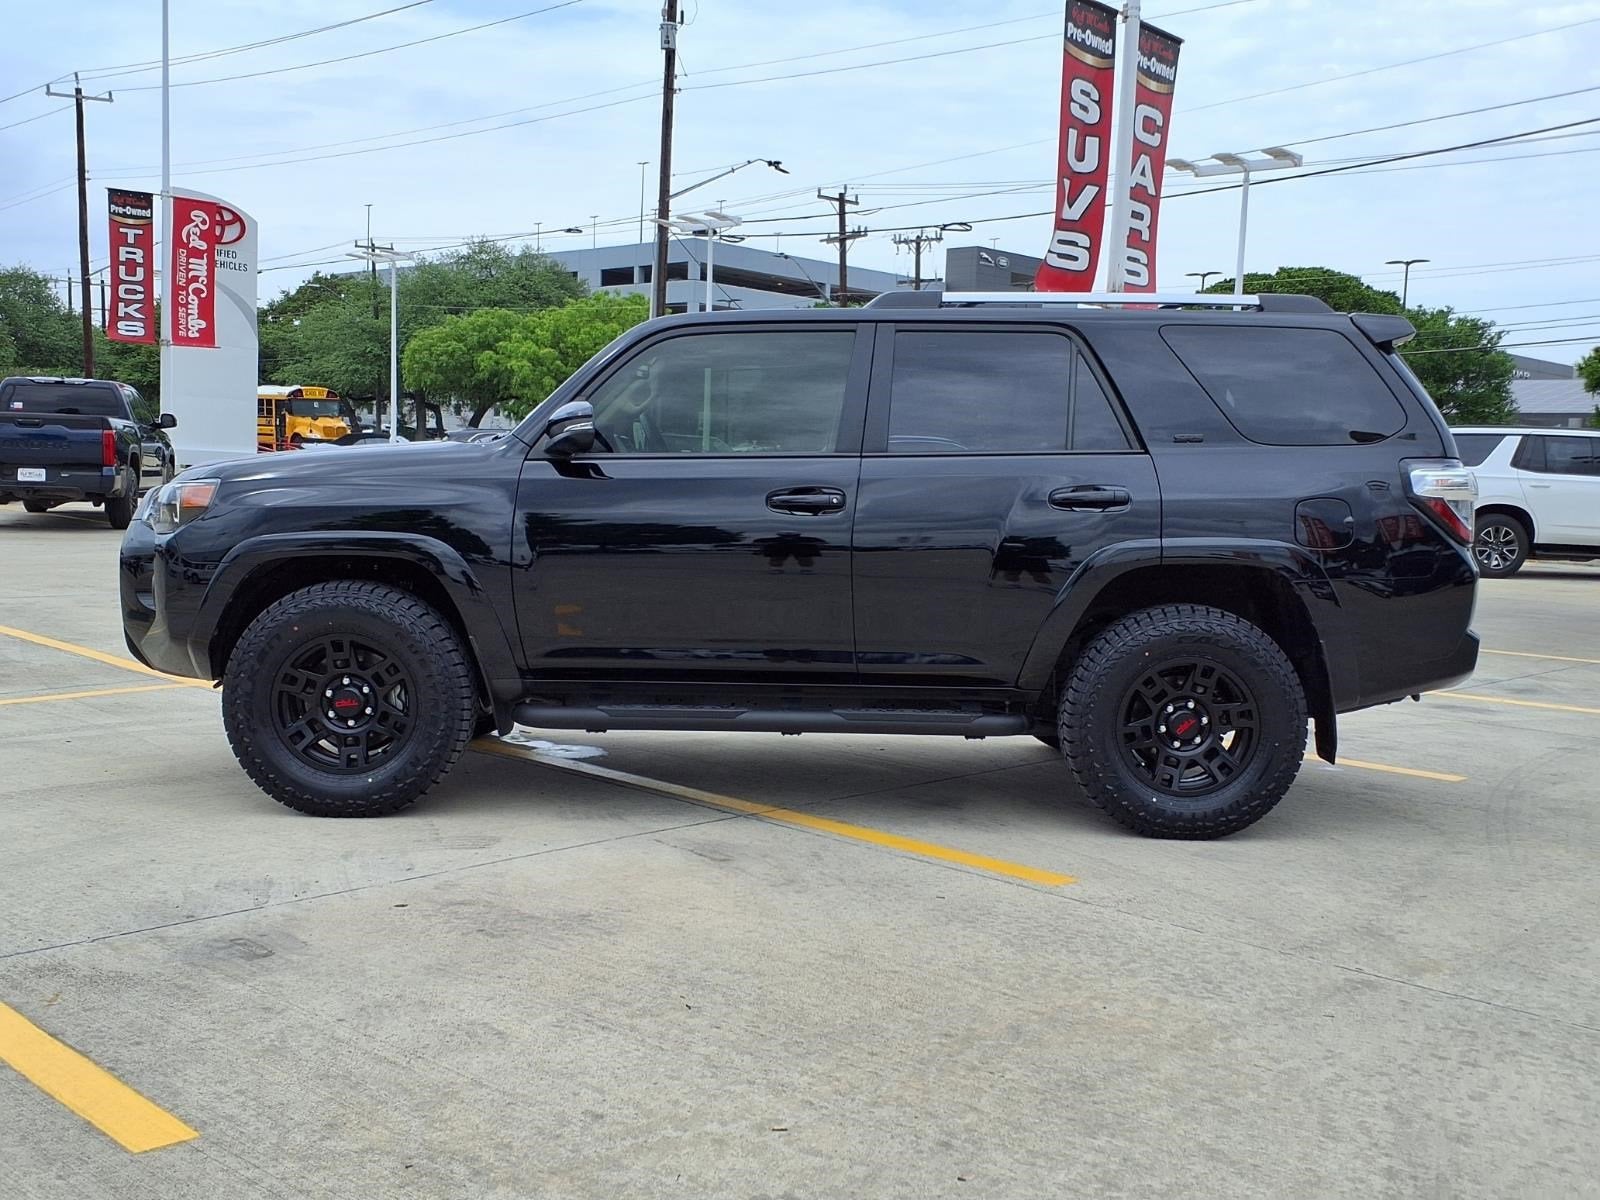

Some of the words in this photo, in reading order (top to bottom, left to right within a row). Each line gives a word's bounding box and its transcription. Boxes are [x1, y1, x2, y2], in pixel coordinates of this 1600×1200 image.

[1067, 22, 1113, 55] Pre-Owned
[1137, 51, 1176, 81] Pre-Owned
[1046, 78, 1101, 272] SUVS
[110, 204, 151, 217] Pre-Owned
[1124, 103, 1163, 287] CARS
[181, 210, 209, 251] Red
[117, 227, 145, 337] TRUCKS
[178, 248, 187, 287] DRIVEN
[178, 289, 187, 304] TO
[188, 253, 208, 338] McCombs
[178, 306, 187, 337] SERVE
